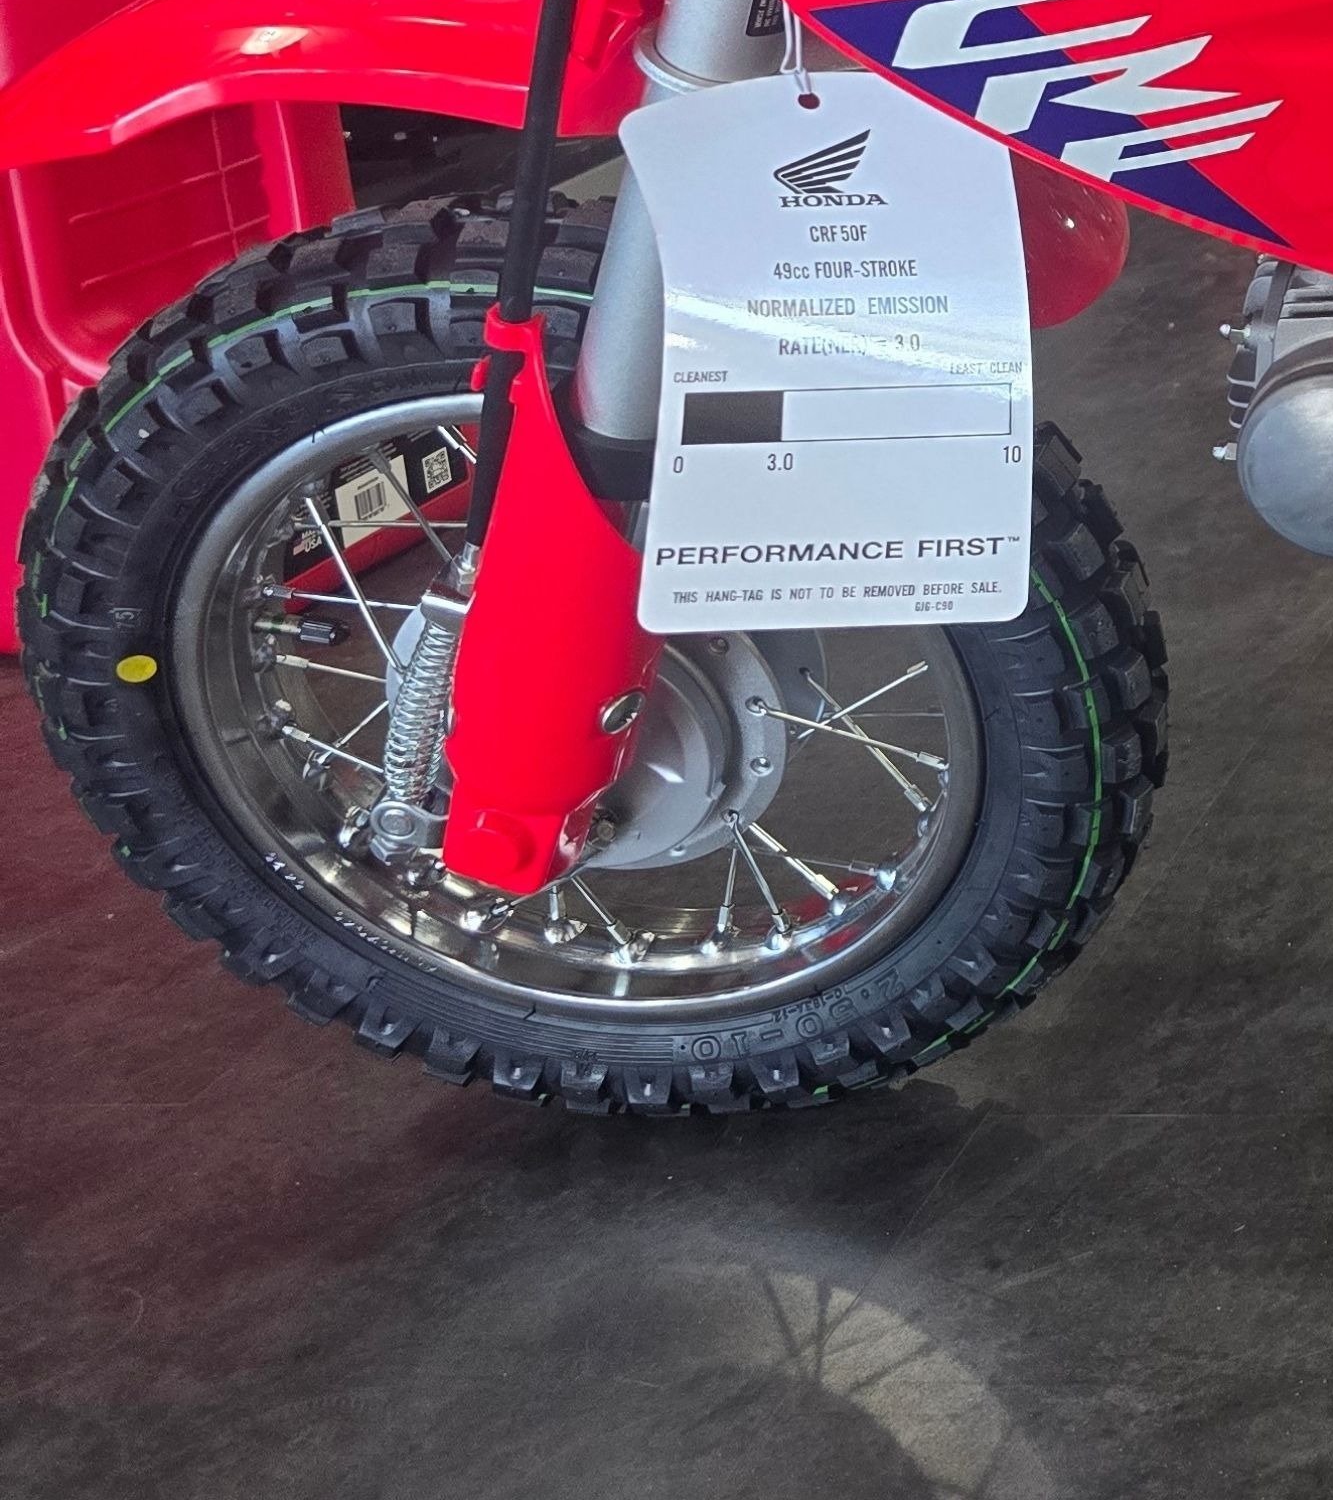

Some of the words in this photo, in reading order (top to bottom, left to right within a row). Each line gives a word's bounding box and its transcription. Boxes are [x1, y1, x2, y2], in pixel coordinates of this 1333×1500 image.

[779, 193, 889, 208] HONDA
[773, 262, 811, 280] 49cc
[815, 259, 918, 280] FOUR-STROKE
[747, 297, 857, 318] NORMALIZED
[868, 295, 950, 315] EMISSION
[673, 370, 729, 384] CLEANEST
[950, 362, 983, 376] LEAST
[989, 361, 1024, 375] CLEAN
[672, 455, 684, 474] 0
[767, 452, 794, 472] 3.0
[1002, 445, 1022, 464] 10
[655, 541, 904, 567] PERFORMANCE
[672, 590, 698, 604] THIS
[705, 589, 763, 603] HANG-TAG
[771, 588, 782, 601] IS
[789, 588, 813, 601] NOT
[819, 586, 834, 599] TO
[842, 586, 857, 598] BE
[863, 584, 916, 598] REMOVED
[922, 582, 964, 596] BEFORE
[971, 581, 1003, 594] SALE.
